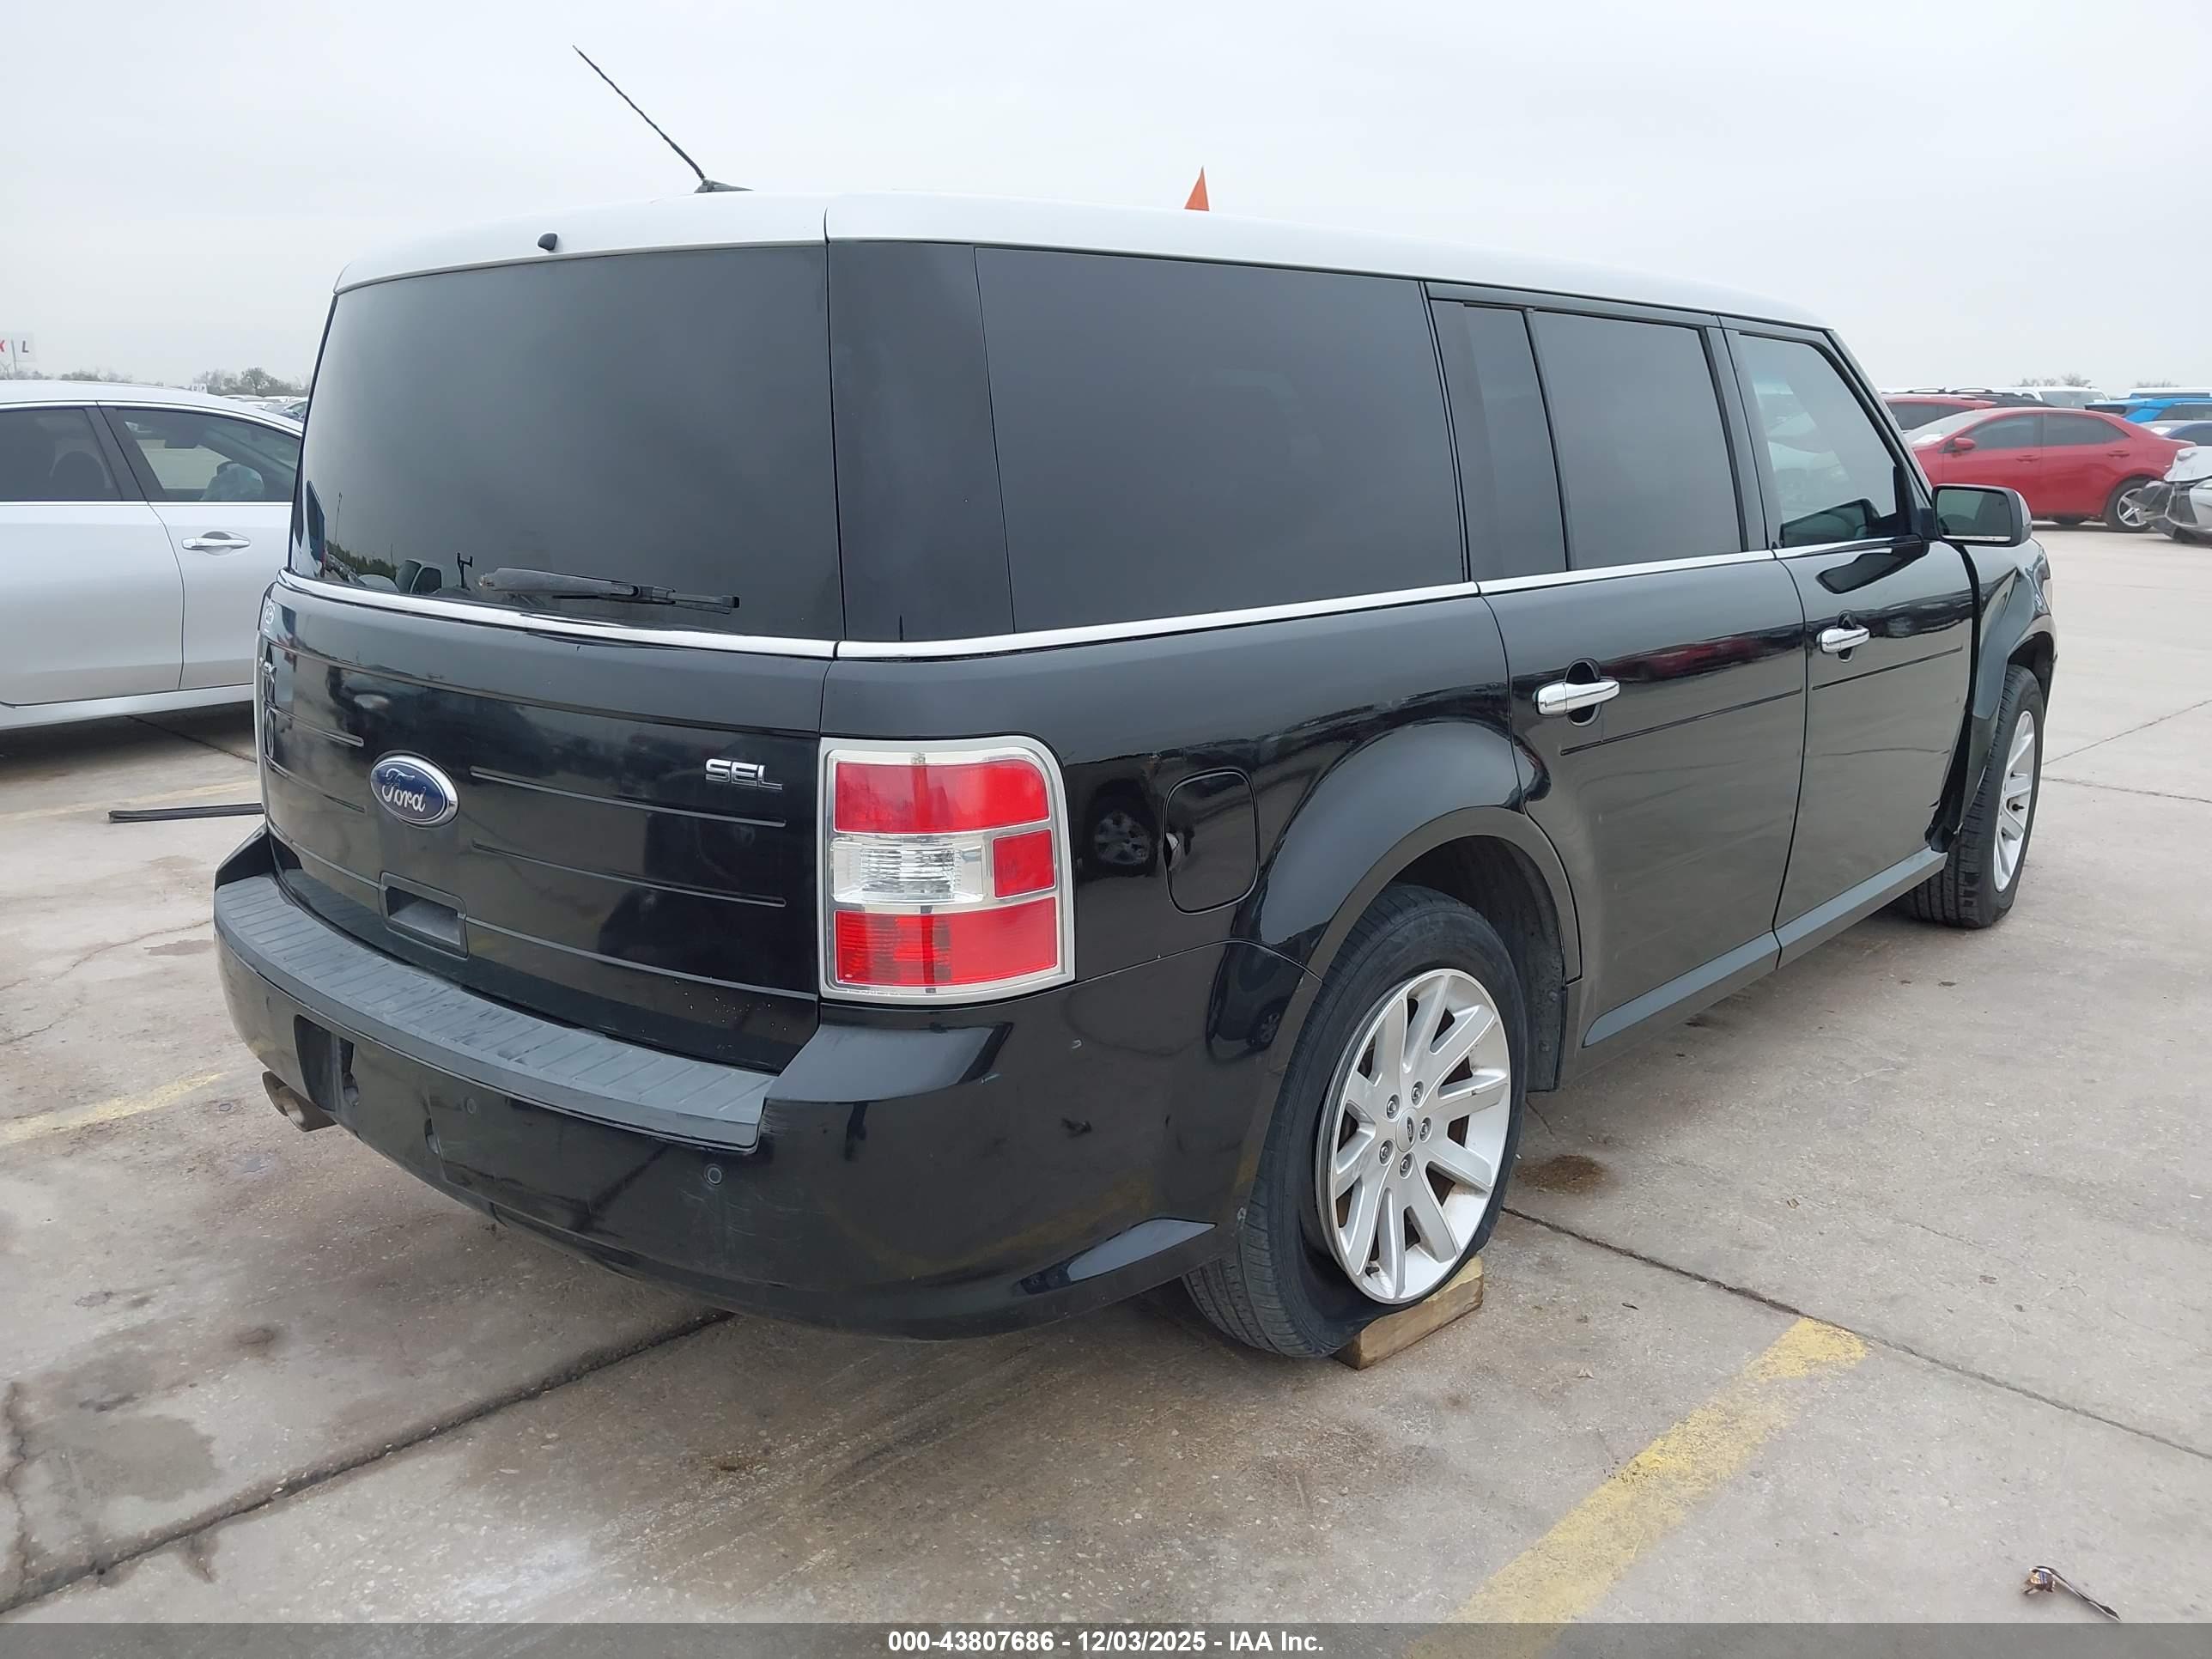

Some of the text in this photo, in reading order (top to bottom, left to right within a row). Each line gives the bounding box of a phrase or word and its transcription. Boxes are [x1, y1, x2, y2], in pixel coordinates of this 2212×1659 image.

[21, 340, 29, 353] L
[381, 768, 427, 812] Ford
[706, 758, 783, 790] SEL
